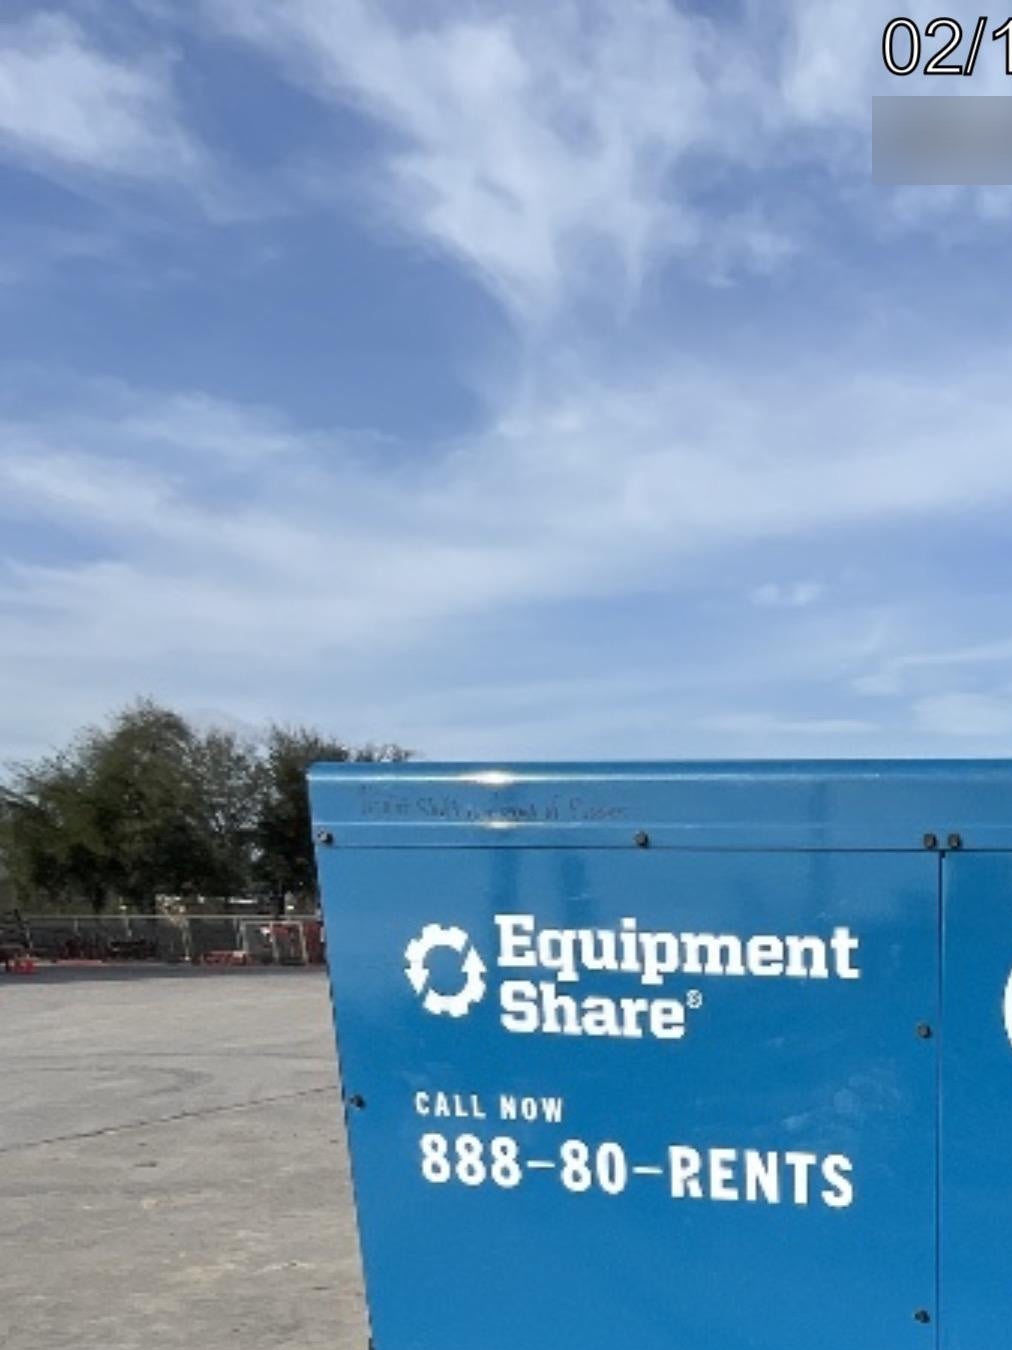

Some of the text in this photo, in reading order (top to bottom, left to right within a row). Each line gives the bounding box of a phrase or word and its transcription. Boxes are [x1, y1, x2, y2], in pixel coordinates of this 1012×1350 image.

[494, 914, 860, 985] Equipment
[415, 1091, 563, 1123] CALL NOW
[420, 1132, 854, 1208] 888-80-RENTS
